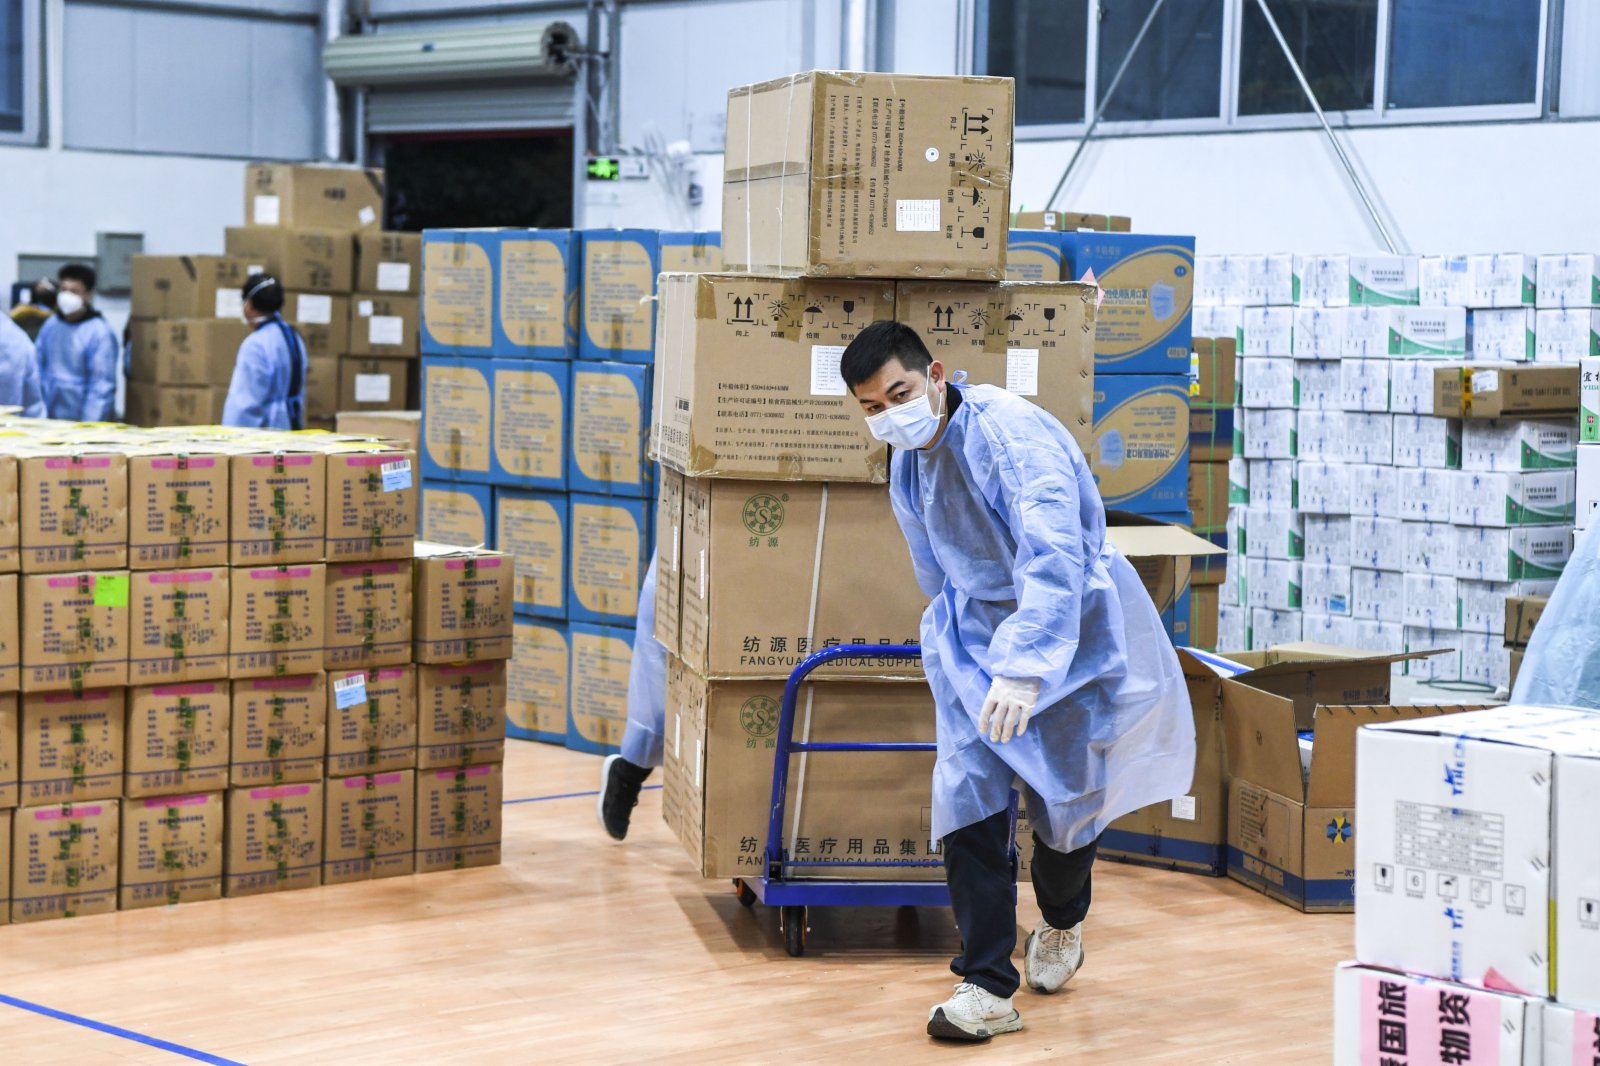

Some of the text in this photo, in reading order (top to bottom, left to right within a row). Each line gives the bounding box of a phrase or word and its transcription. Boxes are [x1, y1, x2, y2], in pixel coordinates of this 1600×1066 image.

[949, 116, 957, 131] 向上
[948, 152, 956, 168] 防晒
[947, 188, 955, 204] 怕雨
[946, 224, 953, 240] 轻放
[770, 331, 785, 339] 防晒
[936, 338, 950, 346] 向上
[748, 536, 779, 548] 纺源
[740, 836, 943, 856] 纺医疗用品集团
